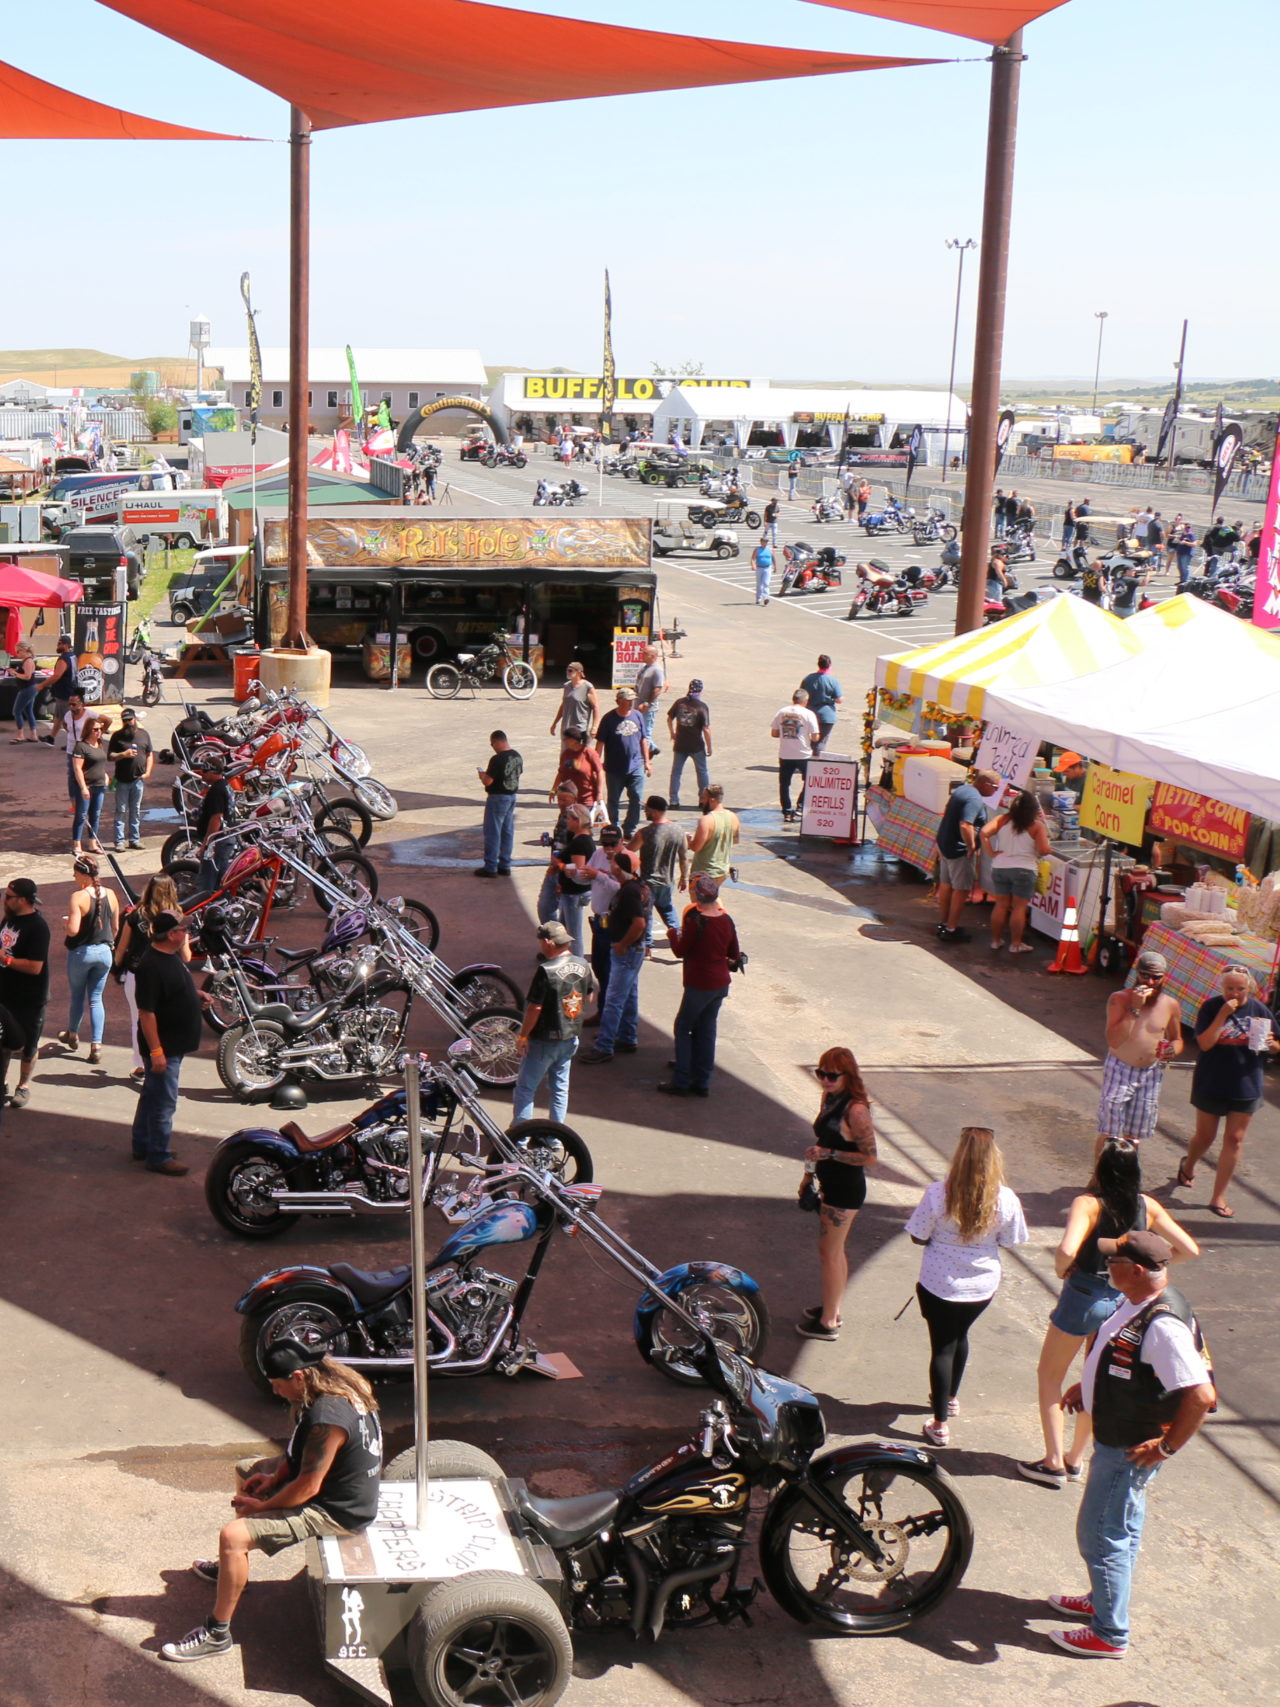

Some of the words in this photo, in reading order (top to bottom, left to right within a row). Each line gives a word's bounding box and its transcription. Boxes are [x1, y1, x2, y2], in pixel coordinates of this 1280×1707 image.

[77, 606, 93, 614] FREE
[808, 776, 852, 790] UNLIMITED
[811, 795, 845, 809] REFILLS
[1205, 799, 1247, 833] CORN
[1095, 804, 1120, 832] Corn
[1163, 815, 1230, 850] POPCORN
[378, 1490, 426, 1572] CHOPPERS
